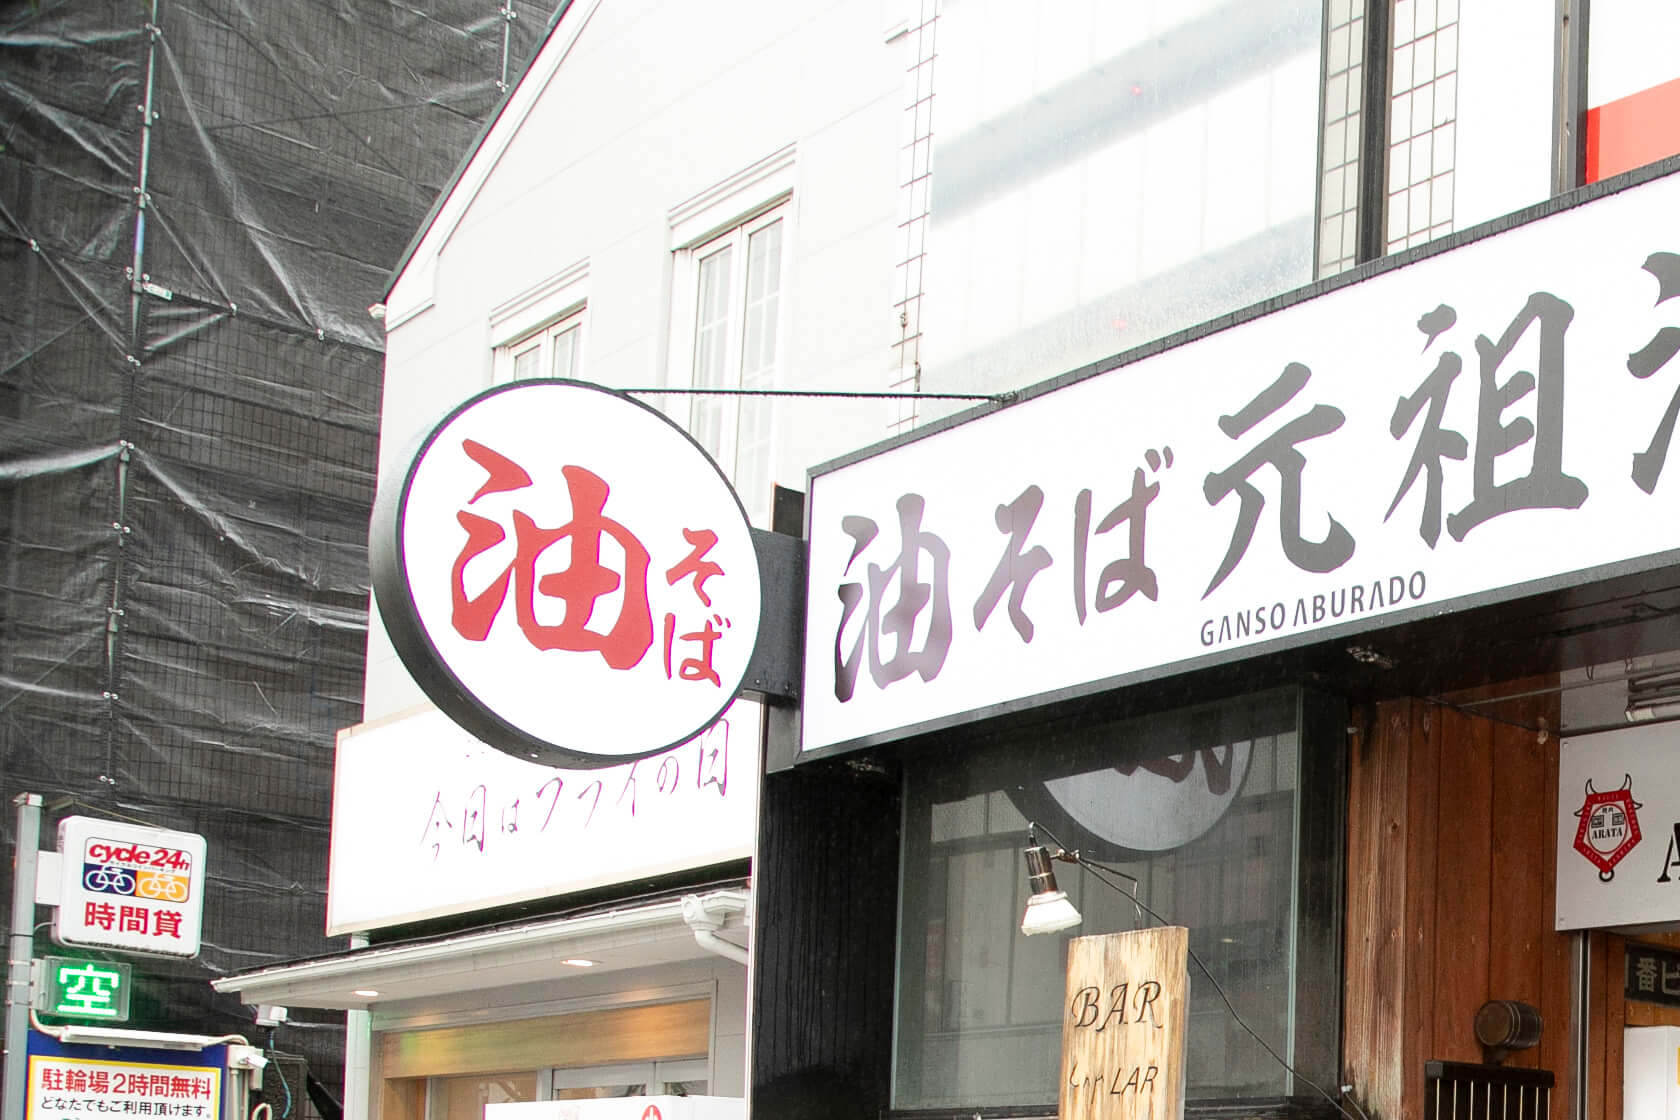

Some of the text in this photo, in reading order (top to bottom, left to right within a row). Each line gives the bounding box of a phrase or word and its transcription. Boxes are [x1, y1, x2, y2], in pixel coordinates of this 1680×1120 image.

[1201, 602, 1284, 647] GANSO
[1592, 827, 1622, 840] ARATA
[84, 901, 183, 939] 時間貸
[58, 964, 120, 1016] 空
[1071, 981, 1163, 1032] BAR
[41, 1068, 211, 1100] 駐輪場2時間無料
[1110, 1066, 1158, 1096] LAR
